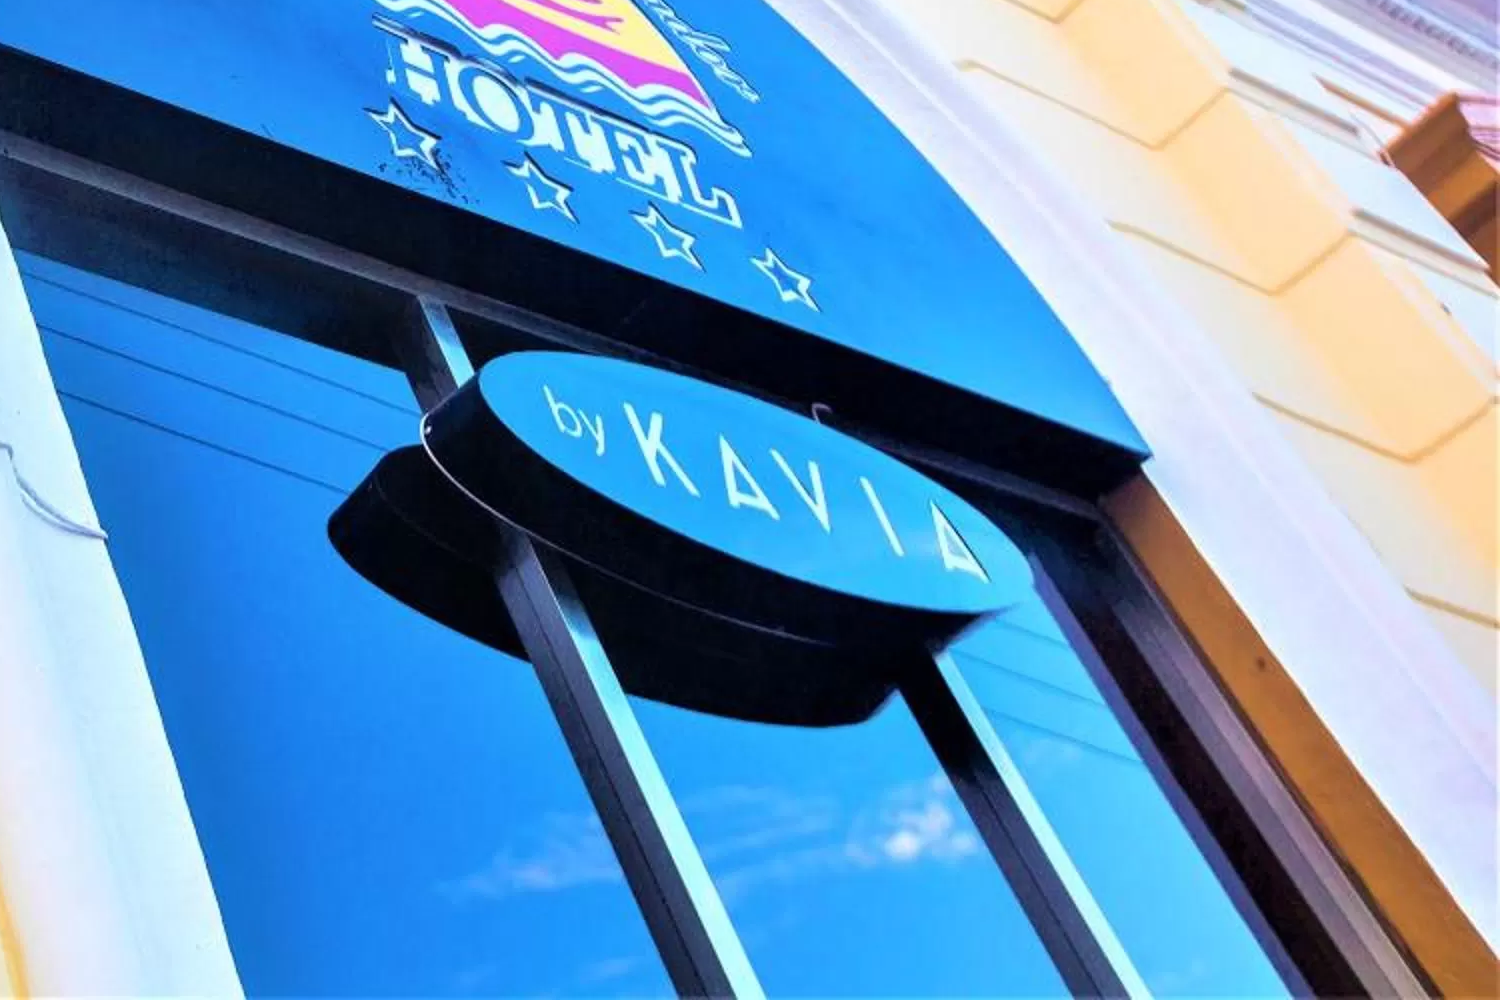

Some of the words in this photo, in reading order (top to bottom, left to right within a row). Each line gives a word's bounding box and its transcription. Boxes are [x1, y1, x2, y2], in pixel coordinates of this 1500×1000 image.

[373, 15, 742, 229] HOTEL
[543, 385, 604, 456] by
[623, 402, 991, 583] KAVIA
